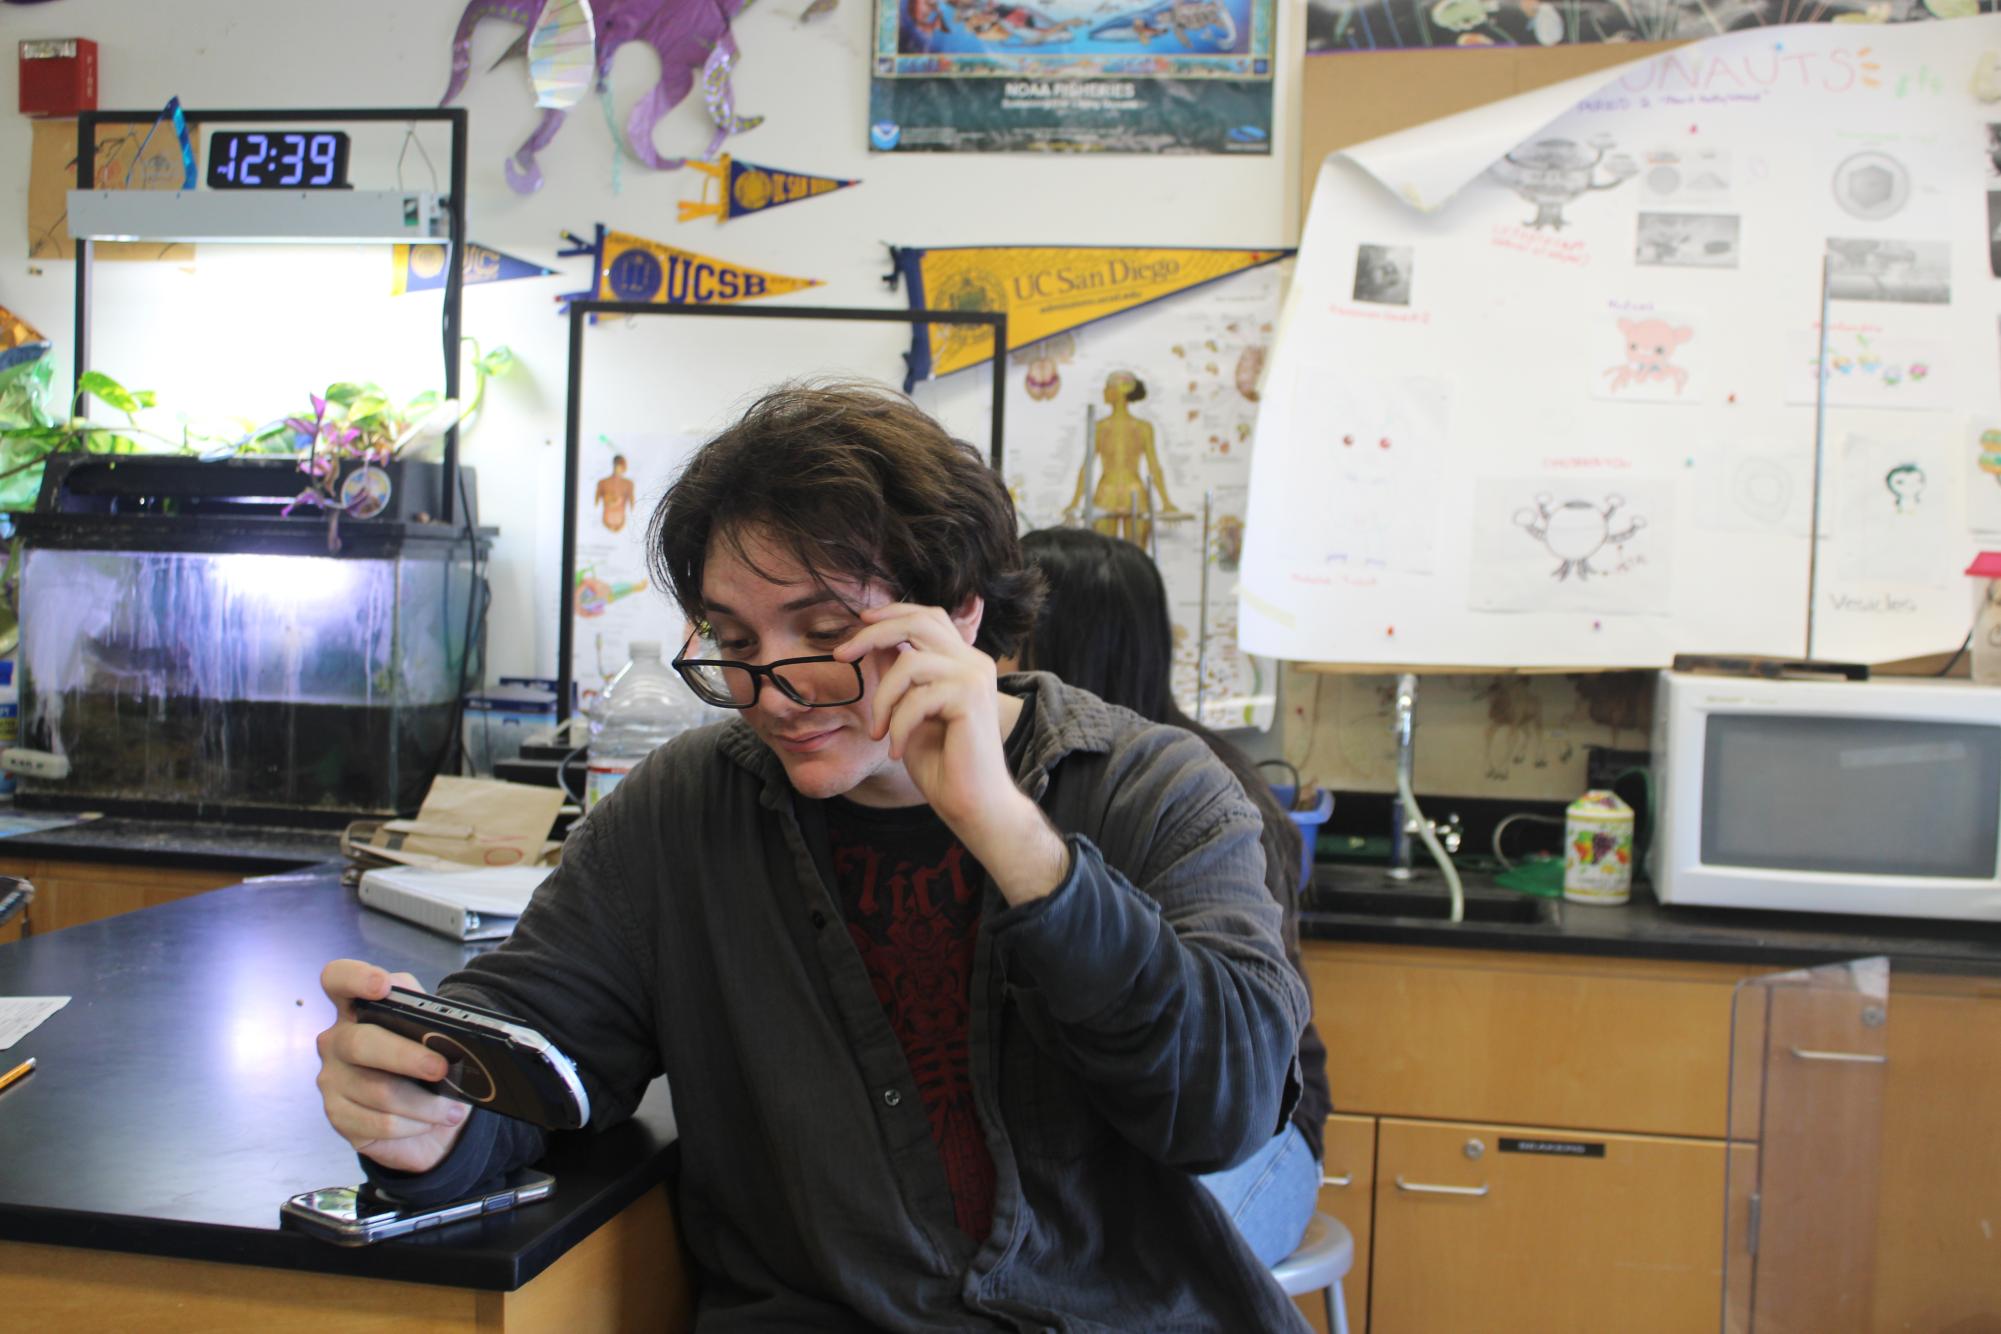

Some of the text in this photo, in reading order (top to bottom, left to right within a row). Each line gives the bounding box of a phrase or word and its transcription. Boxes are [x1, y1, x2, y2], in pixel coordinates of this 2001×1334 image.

[1004, 81, 1136, 98] NOAA FISHERIES
[667, 254, 767, 304] UCSB
[1012, 257, 1182, 300] UC San Diego
